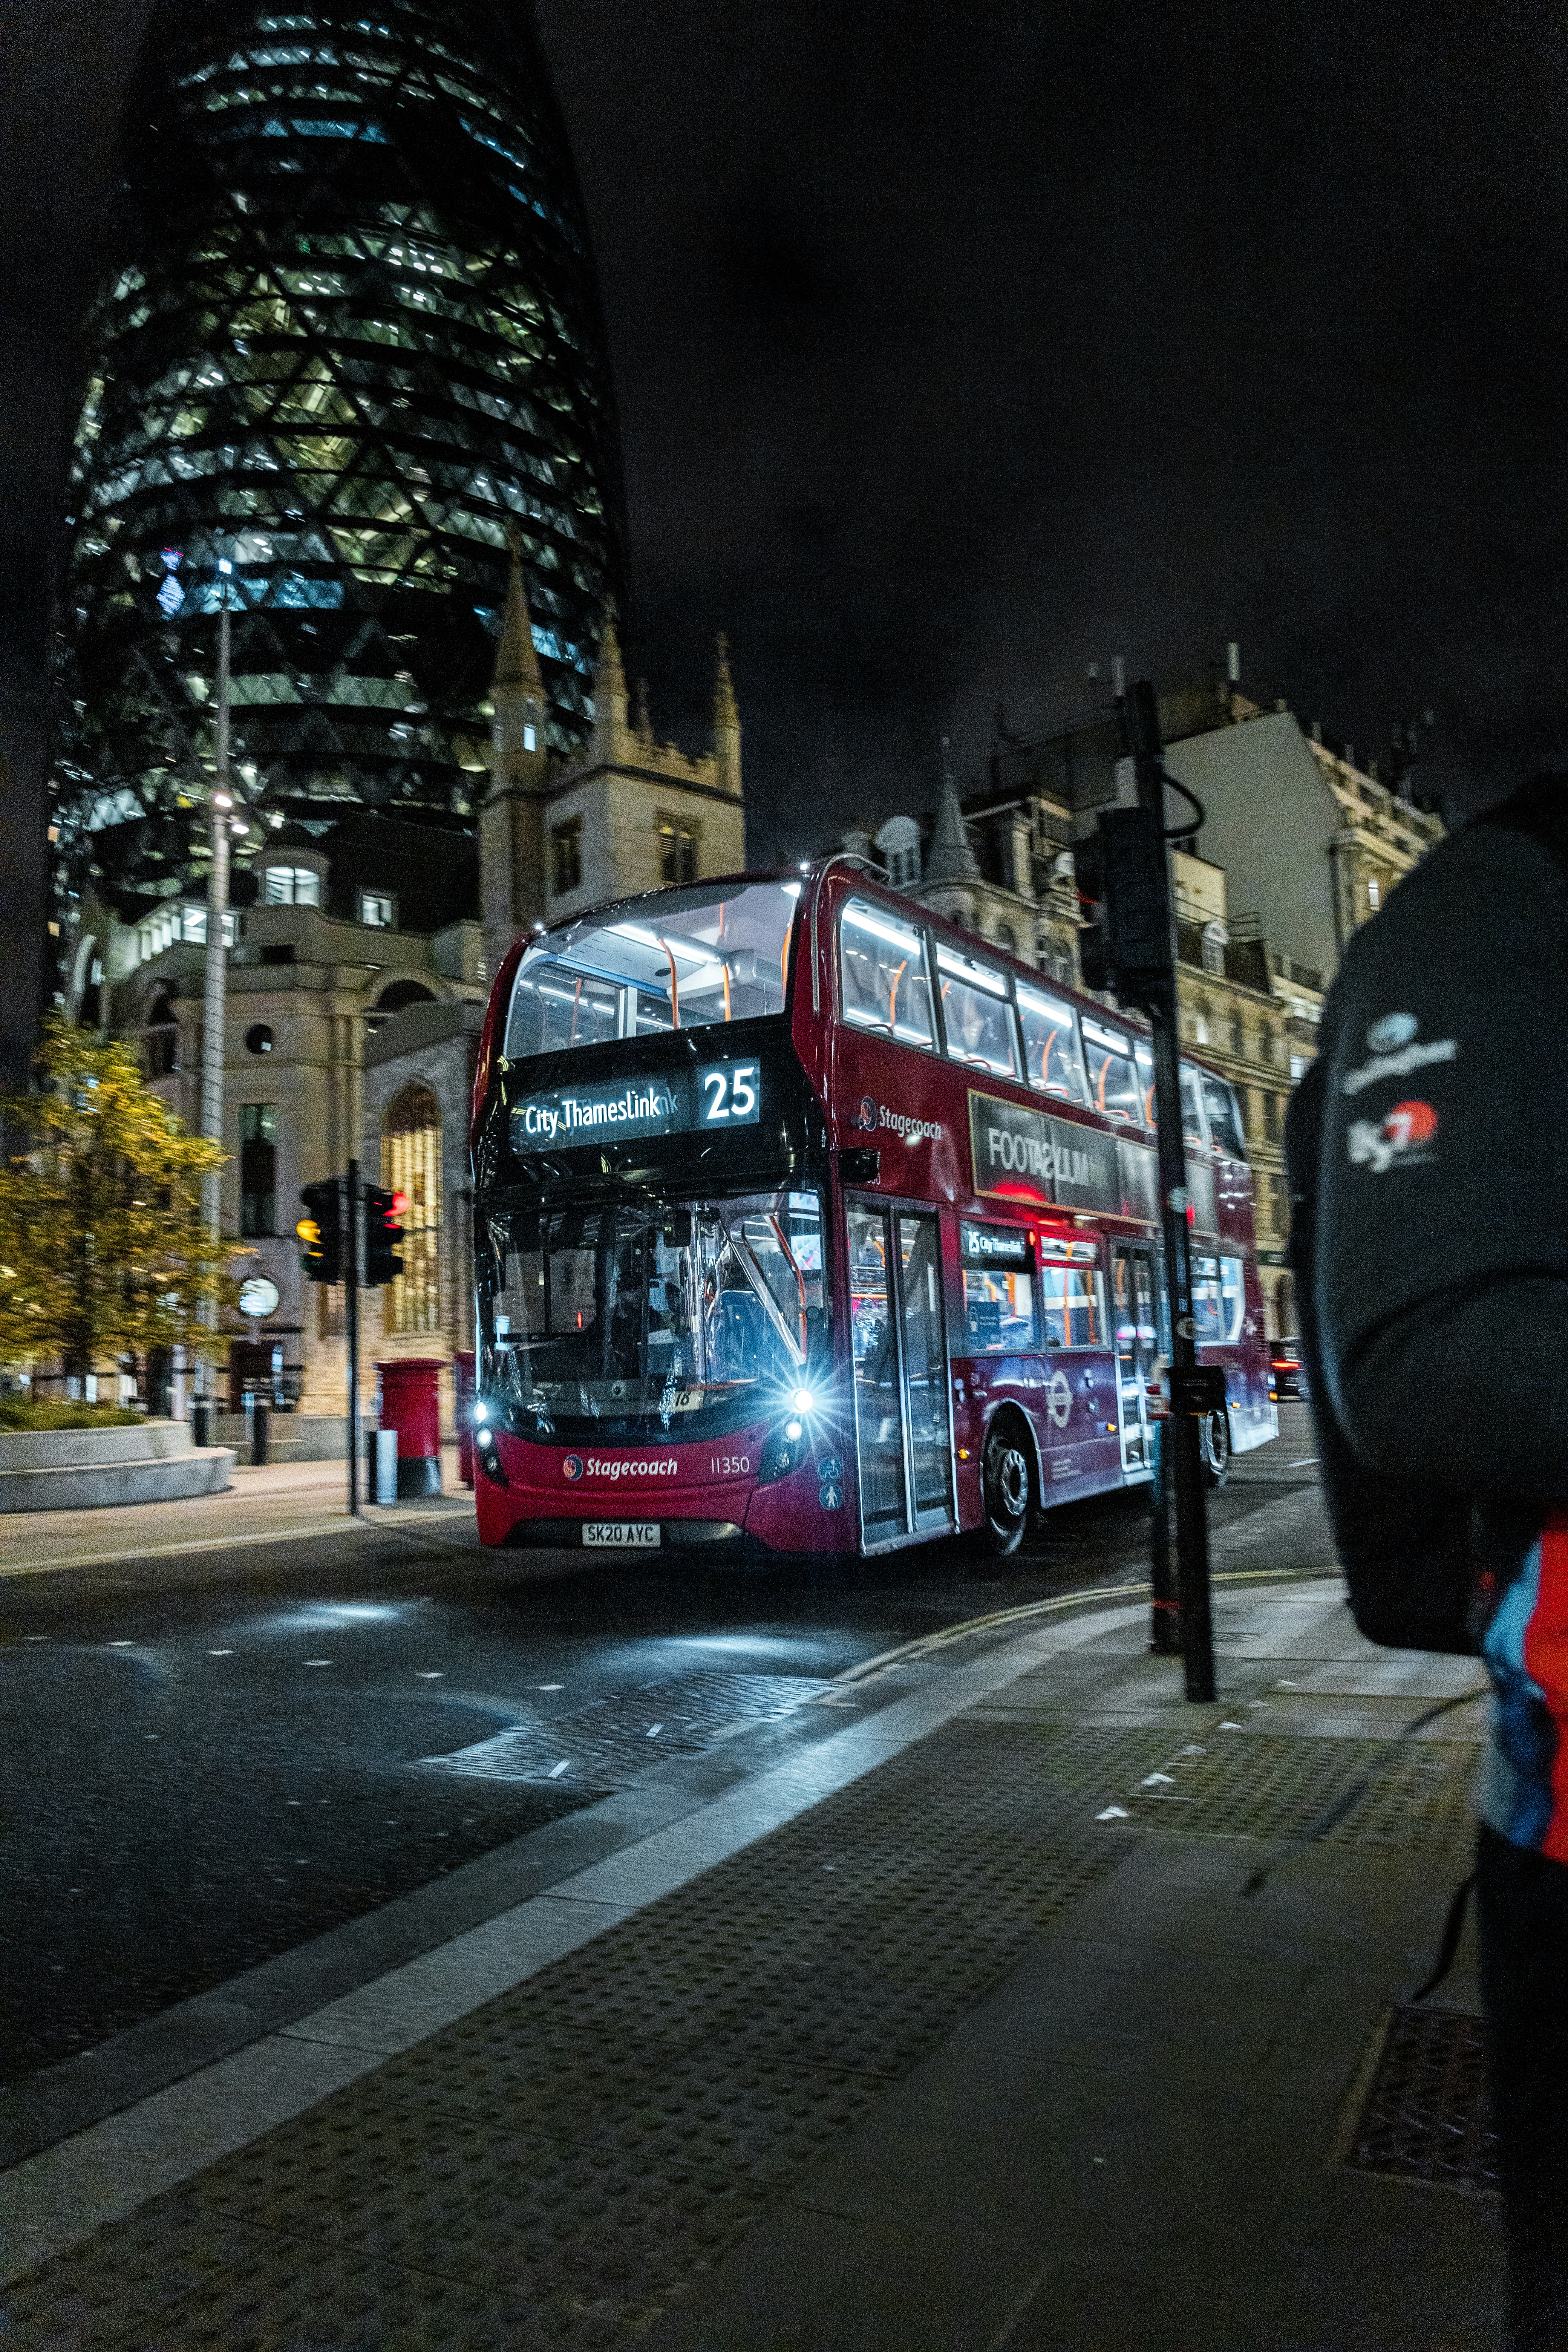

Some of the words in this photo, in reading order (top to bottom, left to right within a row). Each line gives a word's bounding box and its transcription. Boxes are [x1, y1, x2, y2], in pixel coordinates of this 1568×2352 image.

[705, 1067, 754, 1119] 25
[527, 1107, 558, 1138] City
[562, 1088, 660, 1128] Thameslink
[880, 1106, 941, 1140] Stagecoach
[586, 1458, 678, 1480] Stagecoach
[712, 1456, 750, 1473] 11350
[588, 1525, 622, 1542] SK20
[627, 1525, 654, 1542] AYC
